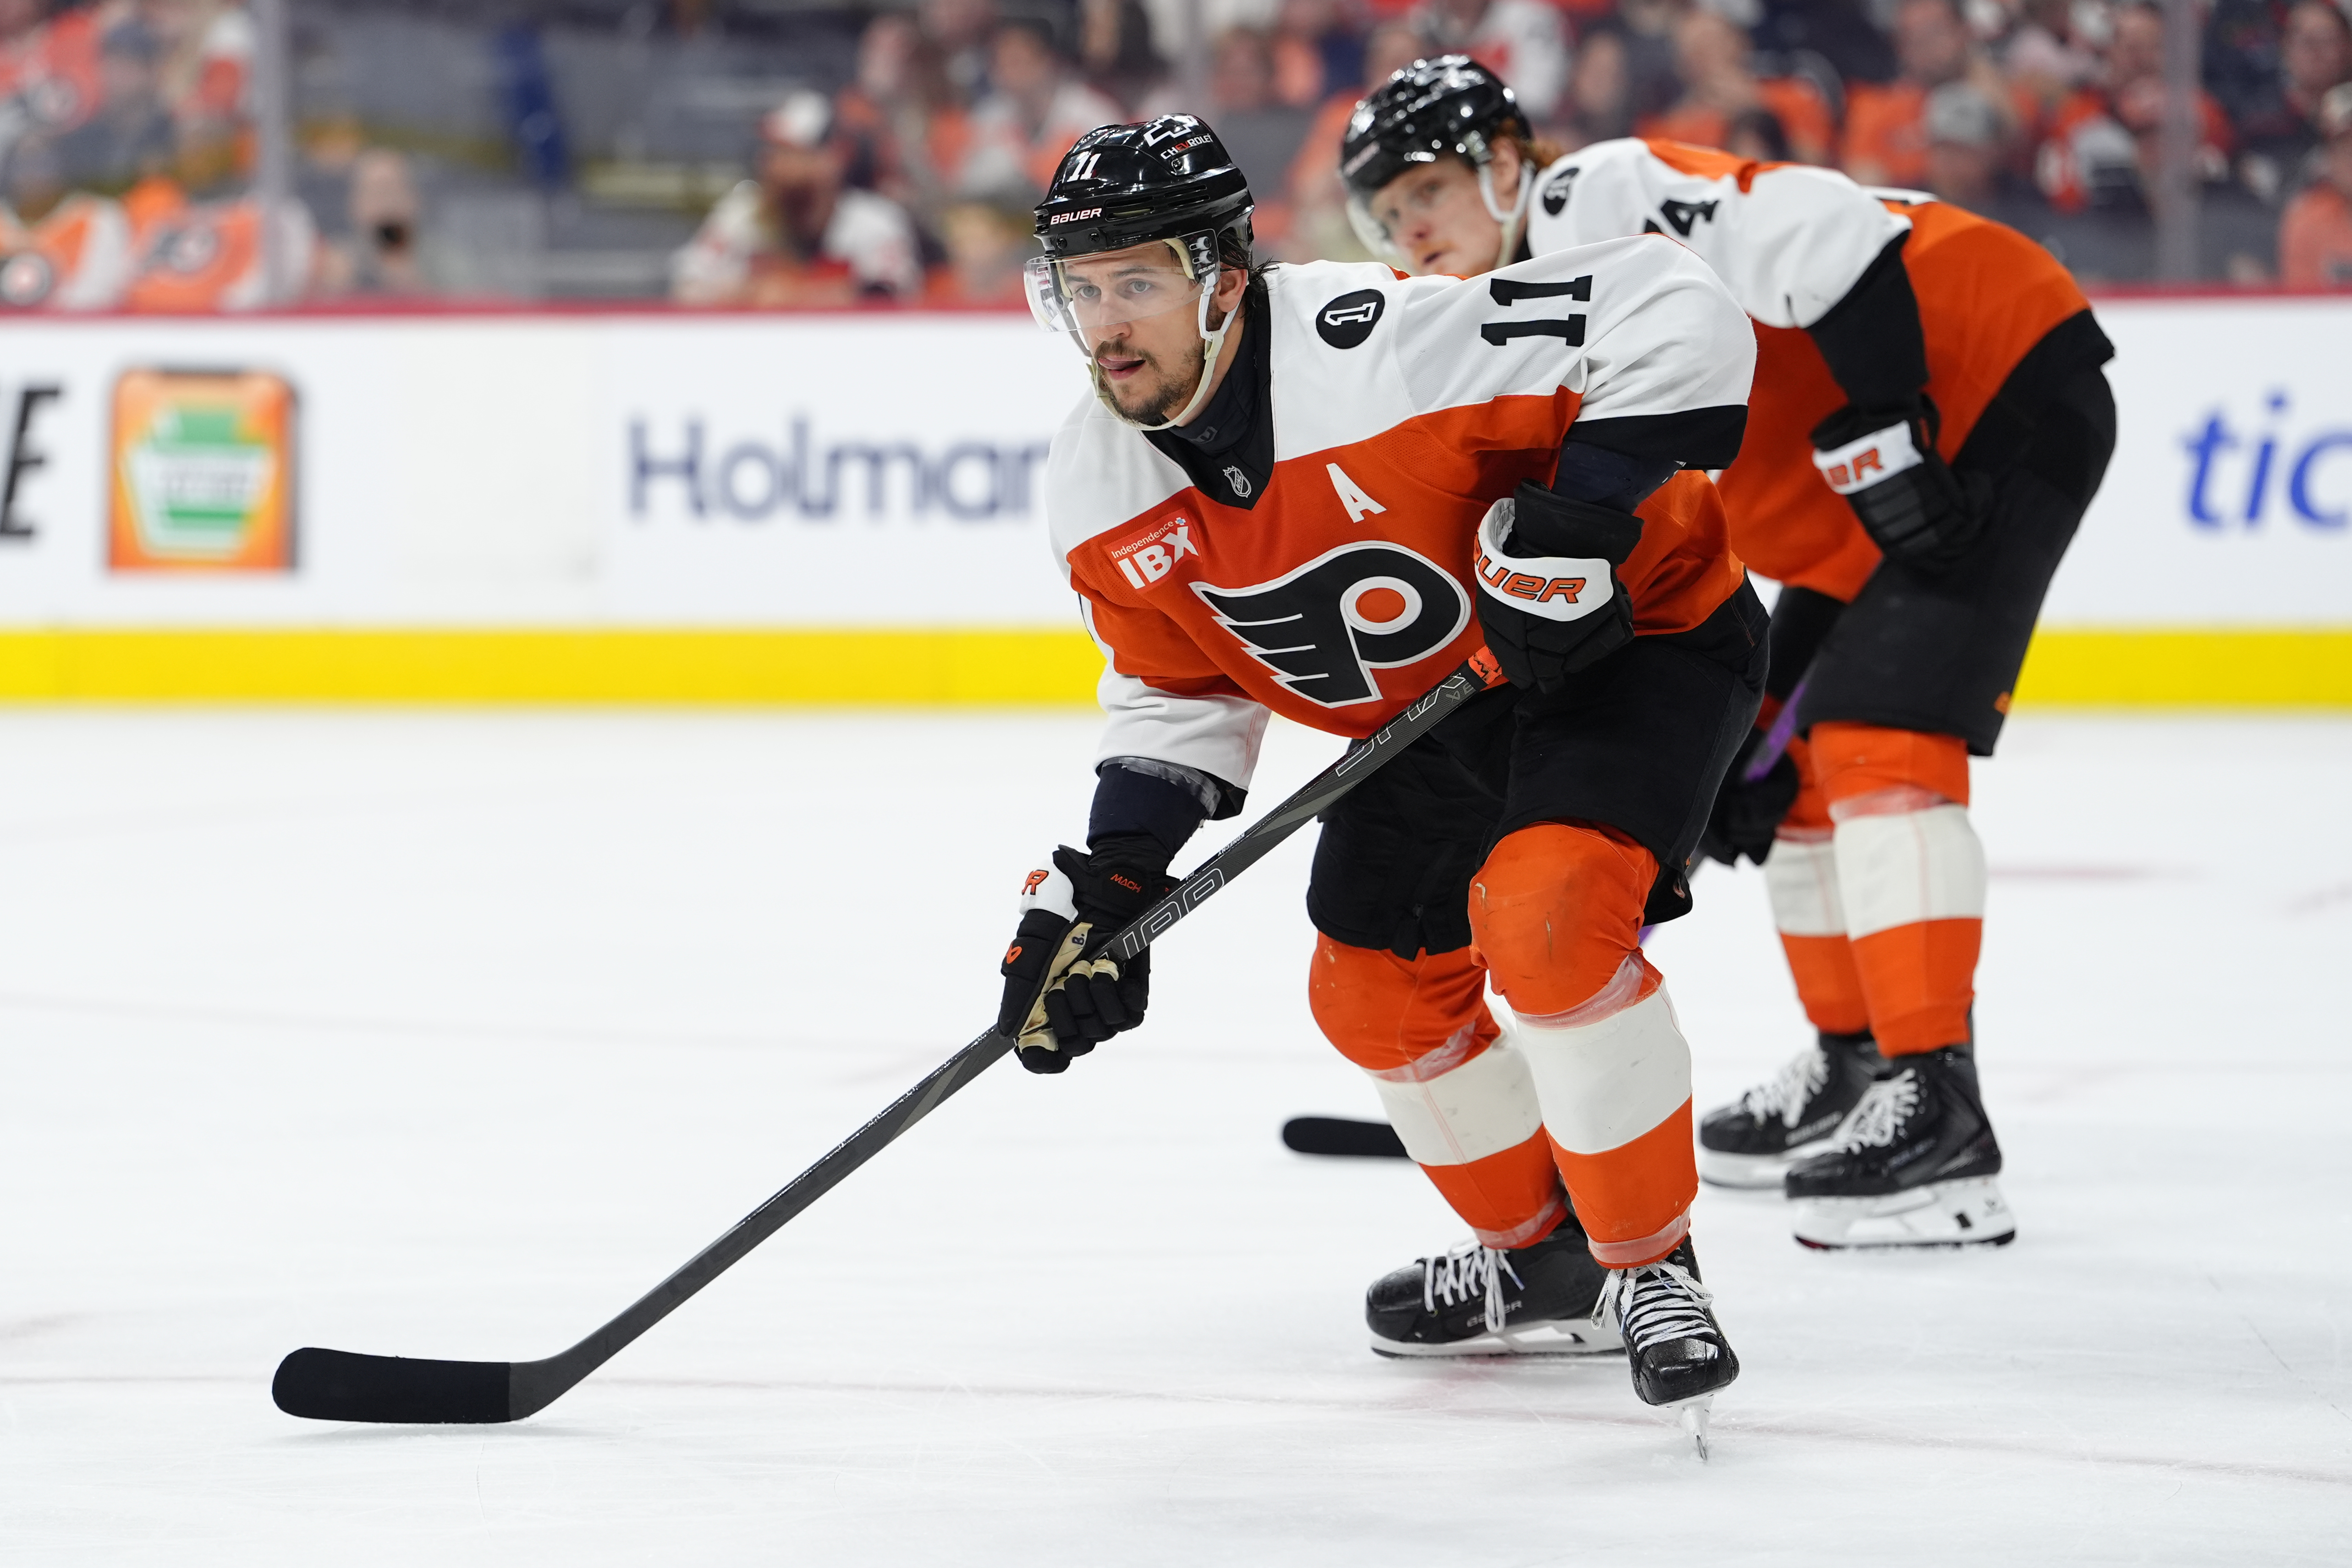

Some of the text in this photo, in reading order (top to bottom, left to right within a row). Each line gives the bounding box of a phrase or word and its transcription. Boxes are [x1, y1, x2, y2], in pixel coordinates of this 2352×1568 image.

[1160, 133, 1213, 159] CHEVROLET
[1066, 154, 1101, 182] 11
[1050, 208, 1102, 225] BAUER
[1644, 199, 1720, 237] 4
[1198, 263, 1215, 274] BAUER
[1324, 301, 1377, 326] 1
[1481, 275, 1593, 347] 11
[1325, 462, 1387, 524] A
[1111, 521, 1174, 559] Independence
[1117, 526, 1199, 589] IBX
[1473, 532, 1586, 603] UER
[1110, 873, 1143, 893] MACH
[1467, 1300, 1522, 1327] BAER
